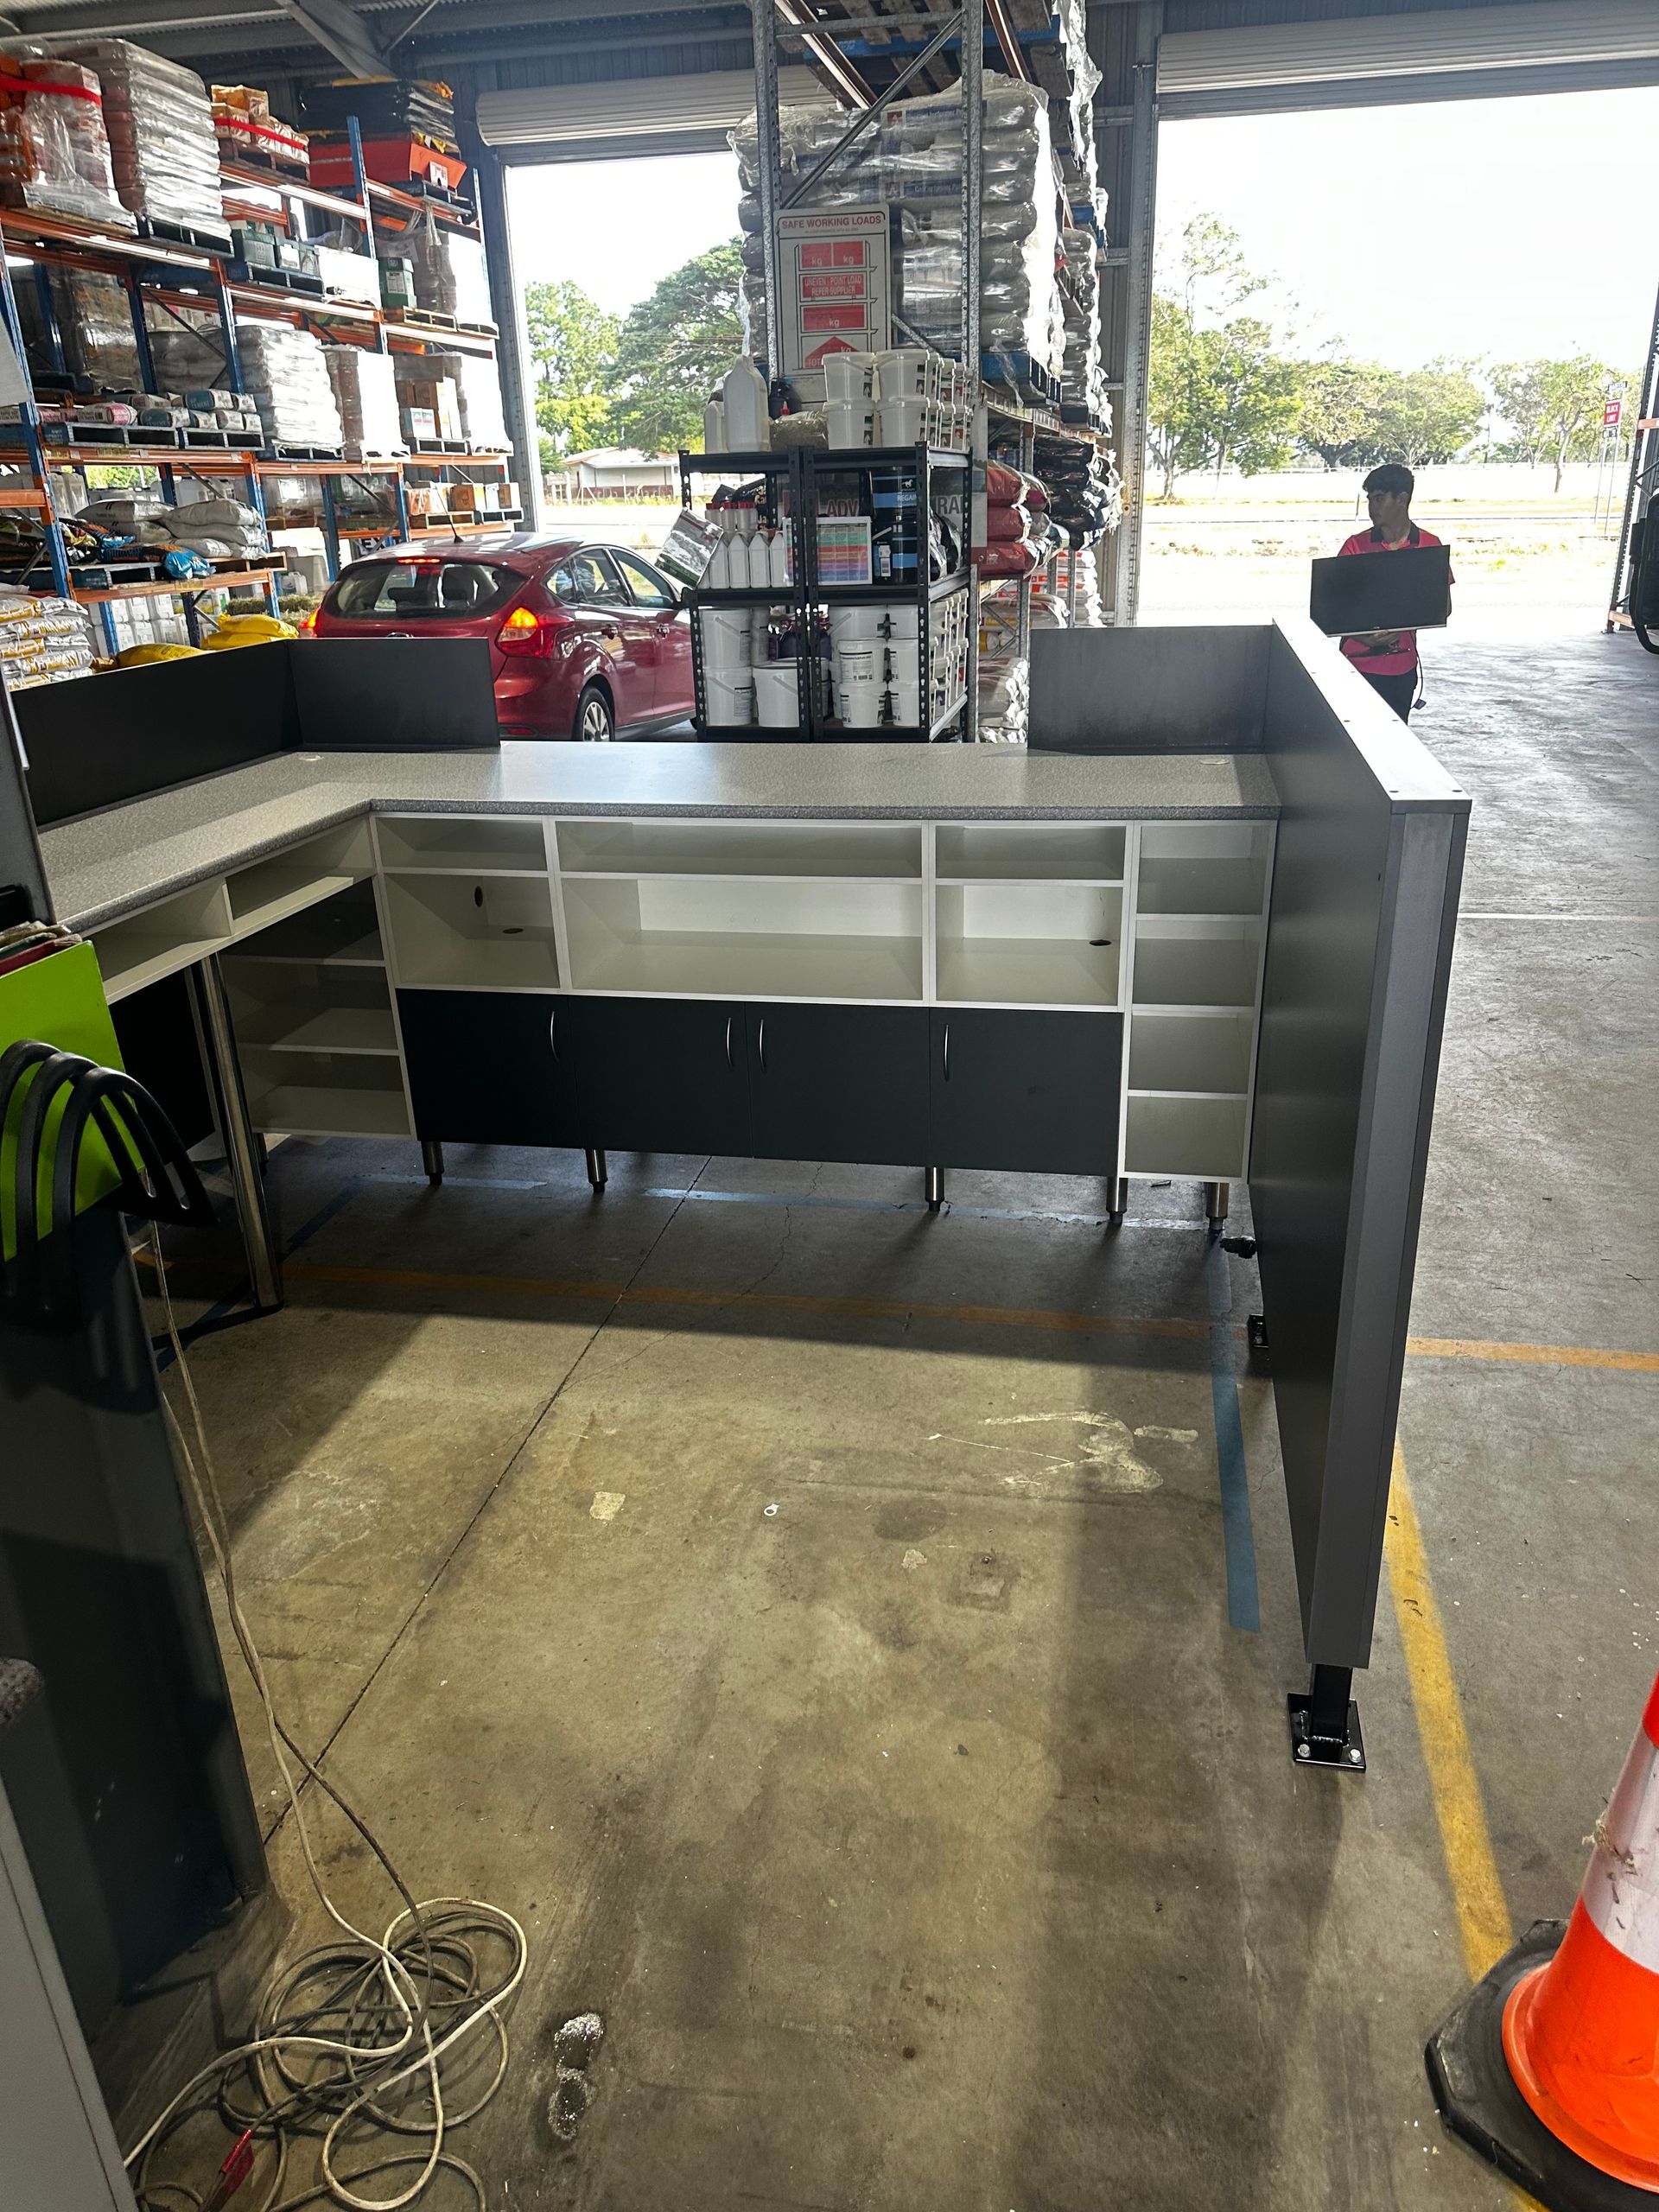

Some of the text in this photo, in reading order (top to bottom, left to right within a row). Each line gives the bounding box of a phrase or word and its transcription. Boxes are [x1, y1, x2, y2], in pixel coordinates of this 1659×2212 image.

[782, 215, 881, 229] SAFE WORKING LOADS
[811, 257, 822, 266] kg
[843, 256, 854, 264] kg
[804, 275, 861, 286] UNEVEN POINT LOAD
[811, 285, 855, 296] REFER SUPPLIER
[830, 318, 840, 327] kg
[827, 499, 859, 517] ADV
